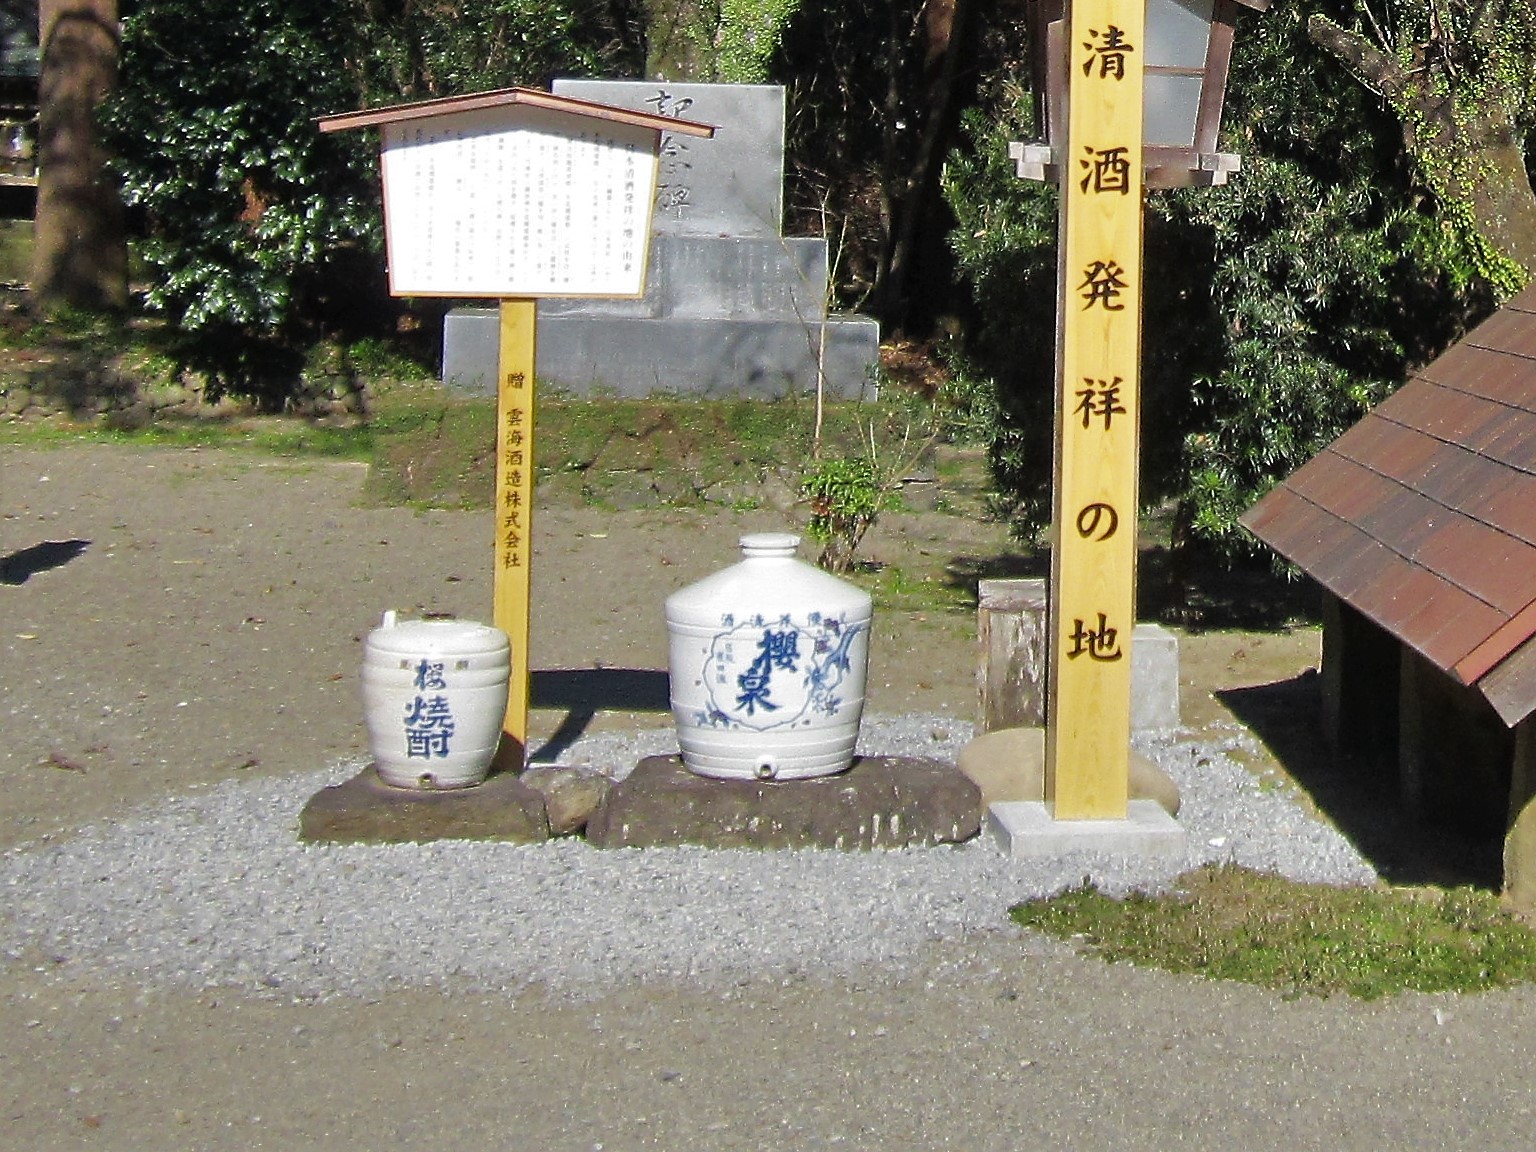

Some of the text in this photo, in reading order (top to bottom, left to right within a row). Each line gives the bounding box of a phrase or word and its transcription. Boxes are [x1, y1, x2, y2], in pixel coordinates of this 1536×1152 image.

[503, 372, 525, 569] 贈 雲海酒造株式会社
